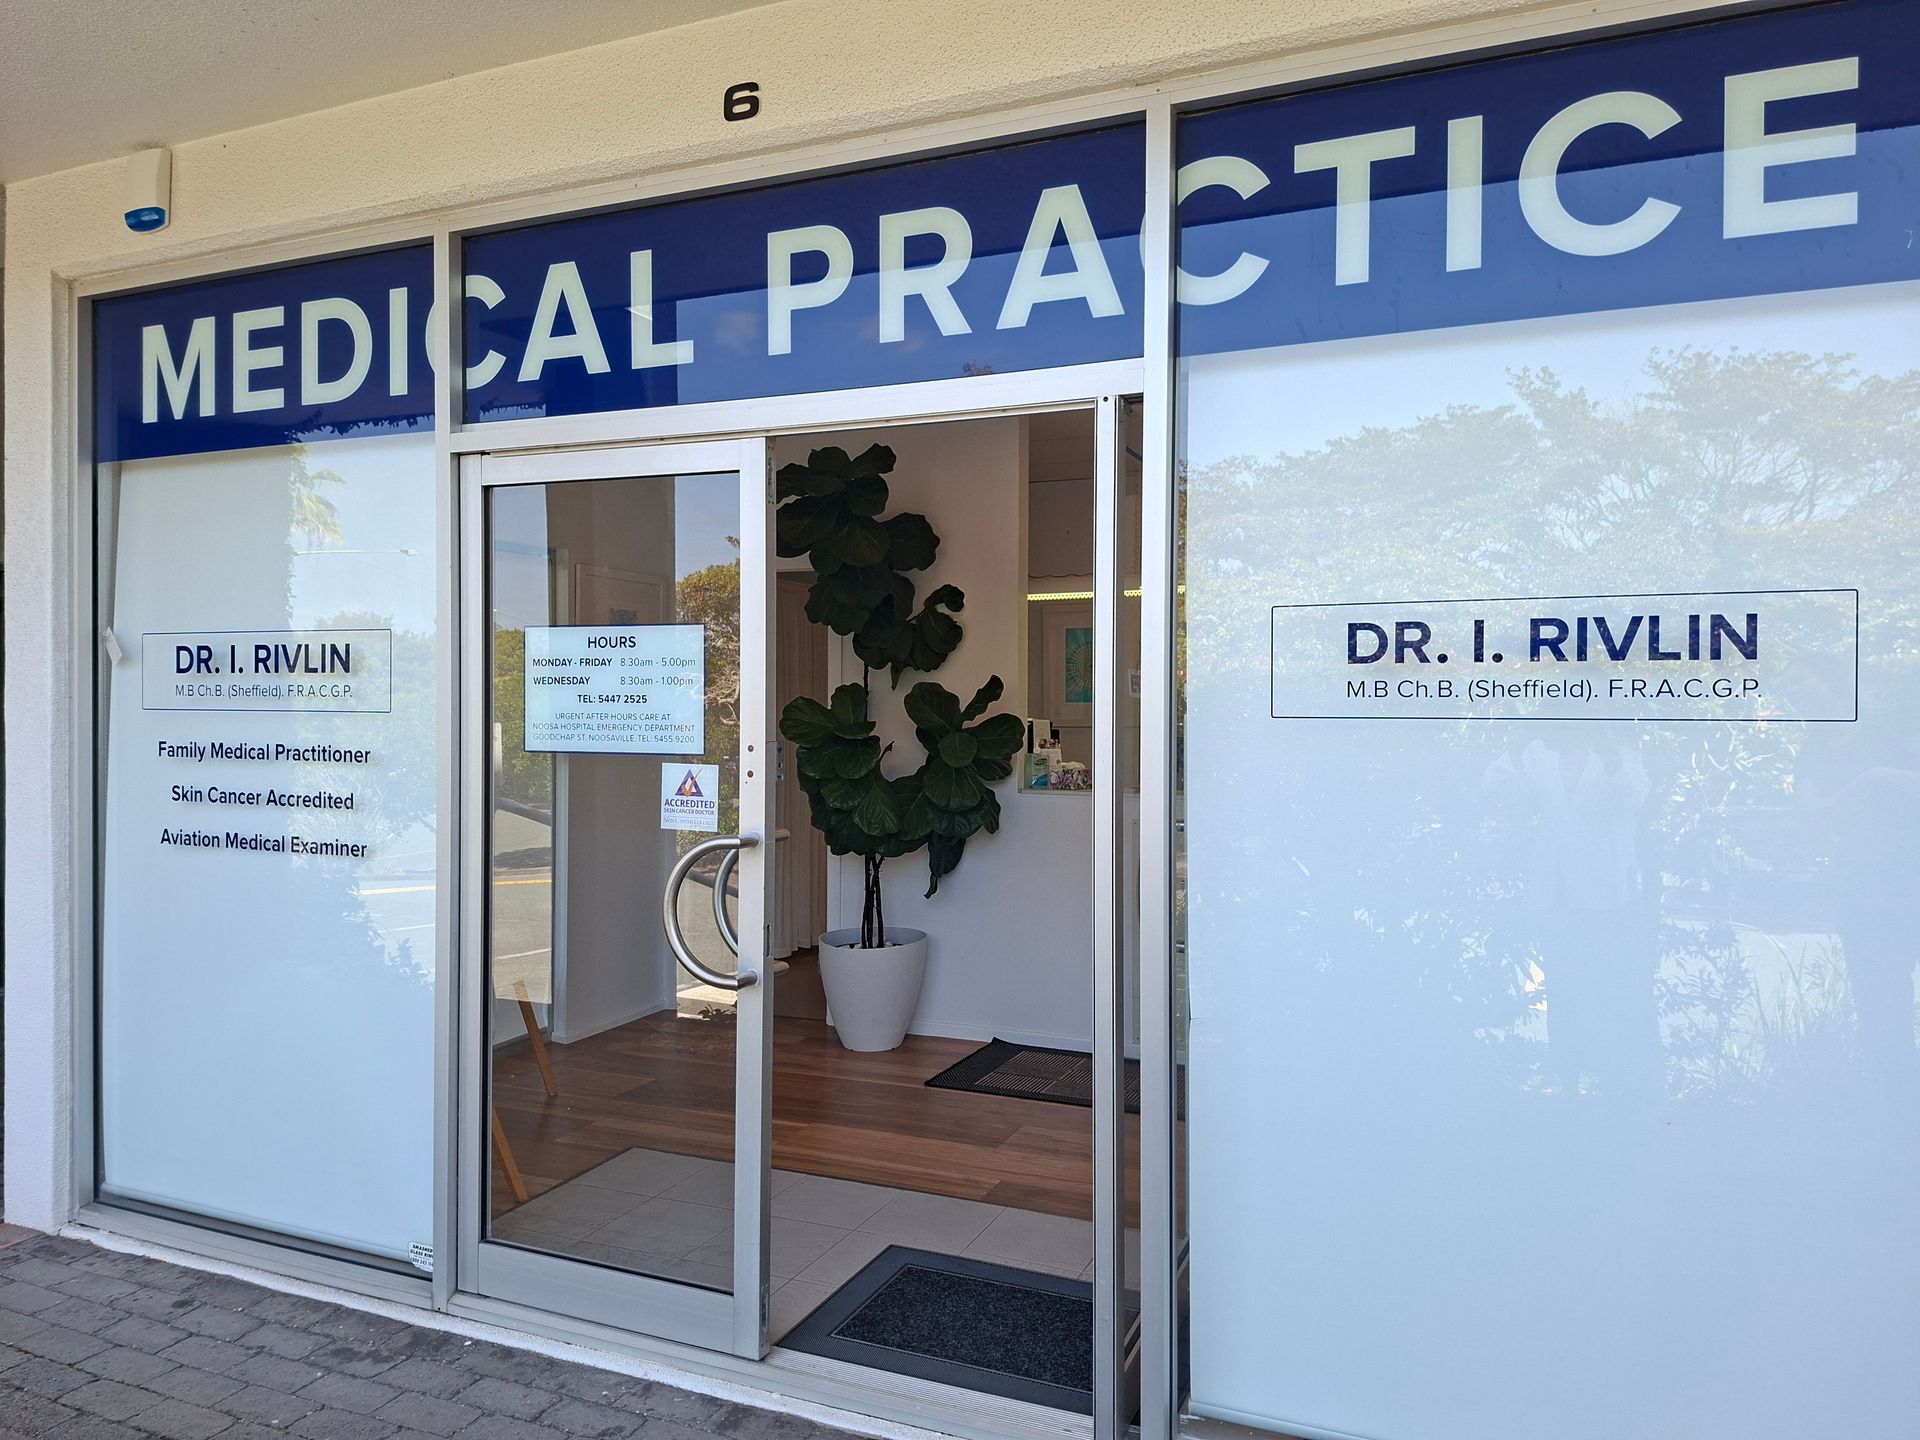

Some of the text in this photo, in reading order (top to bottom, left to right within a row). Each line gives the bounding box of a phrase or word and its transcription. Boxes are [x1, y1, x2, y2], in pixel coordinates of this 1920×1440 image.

[723, 82, 760, 122] 6
[141, 56, 1859, 425] MEDICAL PRACTICE
[587, 636, 637, 649] HOURS
[1346, 613, 1759, 665] DR. I. RIVLIN
[175, 643, 351, 674] DR. I. RIVLIN
[532, 658, 573, 667] MONDAY
[579, 658, 613, 667] FRIDAY
[620, 657, 653, 667] 8.30am
[661, 657, 696, 668] 5.00pm
[533, 676, 591, 685] WEDNESDAY
[620, 676, 653, 685] 8.30am
[661, 676, 694, 687] 1.00pm
[1346, 677, 1763, 701] M.B Ch.B. (Sheffield). F.R.A.C.G.P.
[175, 684, 353, 700] M.B Ch.B. (Sheffield). F.R.A.C.G.P.
[577, 694, 648, 704] TEL: 5447 2525
[555, 712, 585, 720] URGENT
[586, 712, 609, 720] AFTER
[639, 713, 659, 721] CARE
[661, 713, 671, 721] AT
[560, 723, 595, 731] HOSPITAL
[597, 723, 643, 732] EMERGENCY
[644, 724, 695, 732] DEPARTMENT
[533, 733, 576, 741] GOODCHAP
[654, 734, 673, 743] 5455
[675, 735, 695, 743] 9200
[158, 741, 371, 764] Family Medical Practitioner
[171, 785, 354, 810] Skin Cancer Accredited
[664, 799, 715, 809] ACCREDITED
[160, 828, 368, 858] Aviation Medical Examiner
